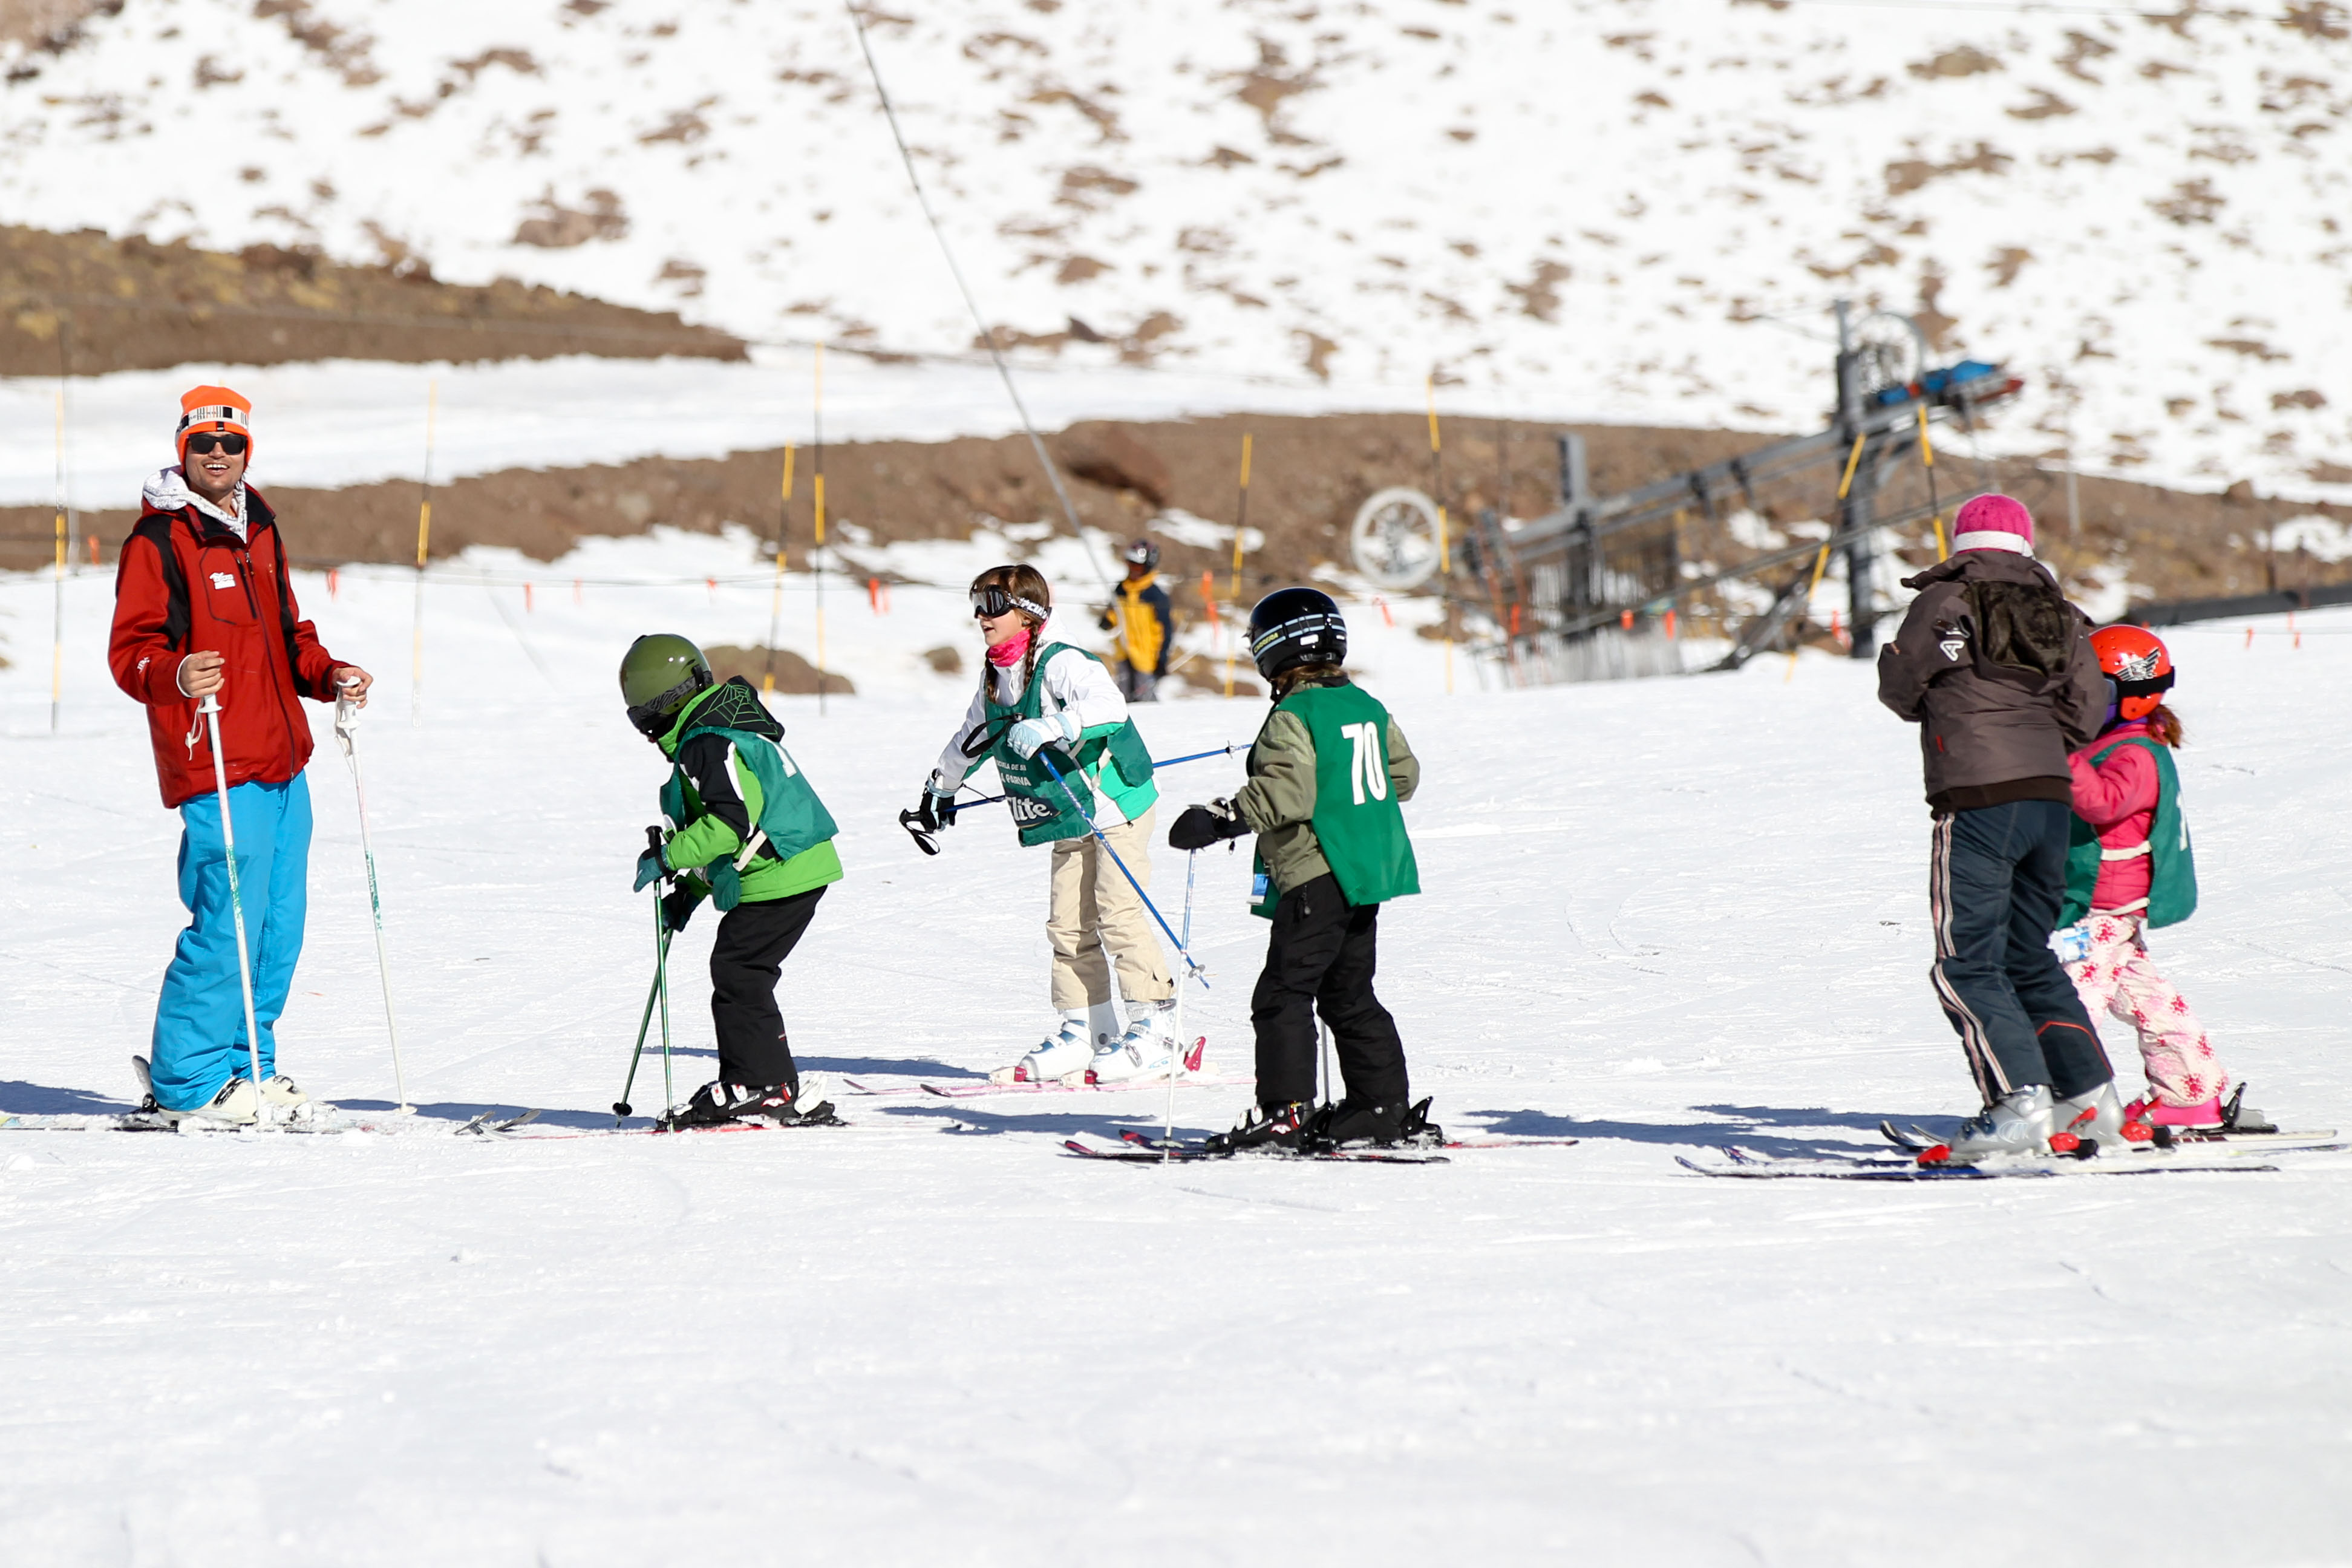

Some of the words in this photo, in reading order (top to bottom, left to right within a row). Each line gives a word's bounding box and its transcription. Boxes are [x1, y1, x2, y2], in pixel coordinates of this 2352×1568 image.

[1341, 721, 1387, 805] 70
[1006, 775, 1031, 786] PARVA
[729, 1093, 760, 1111] NORDICA
